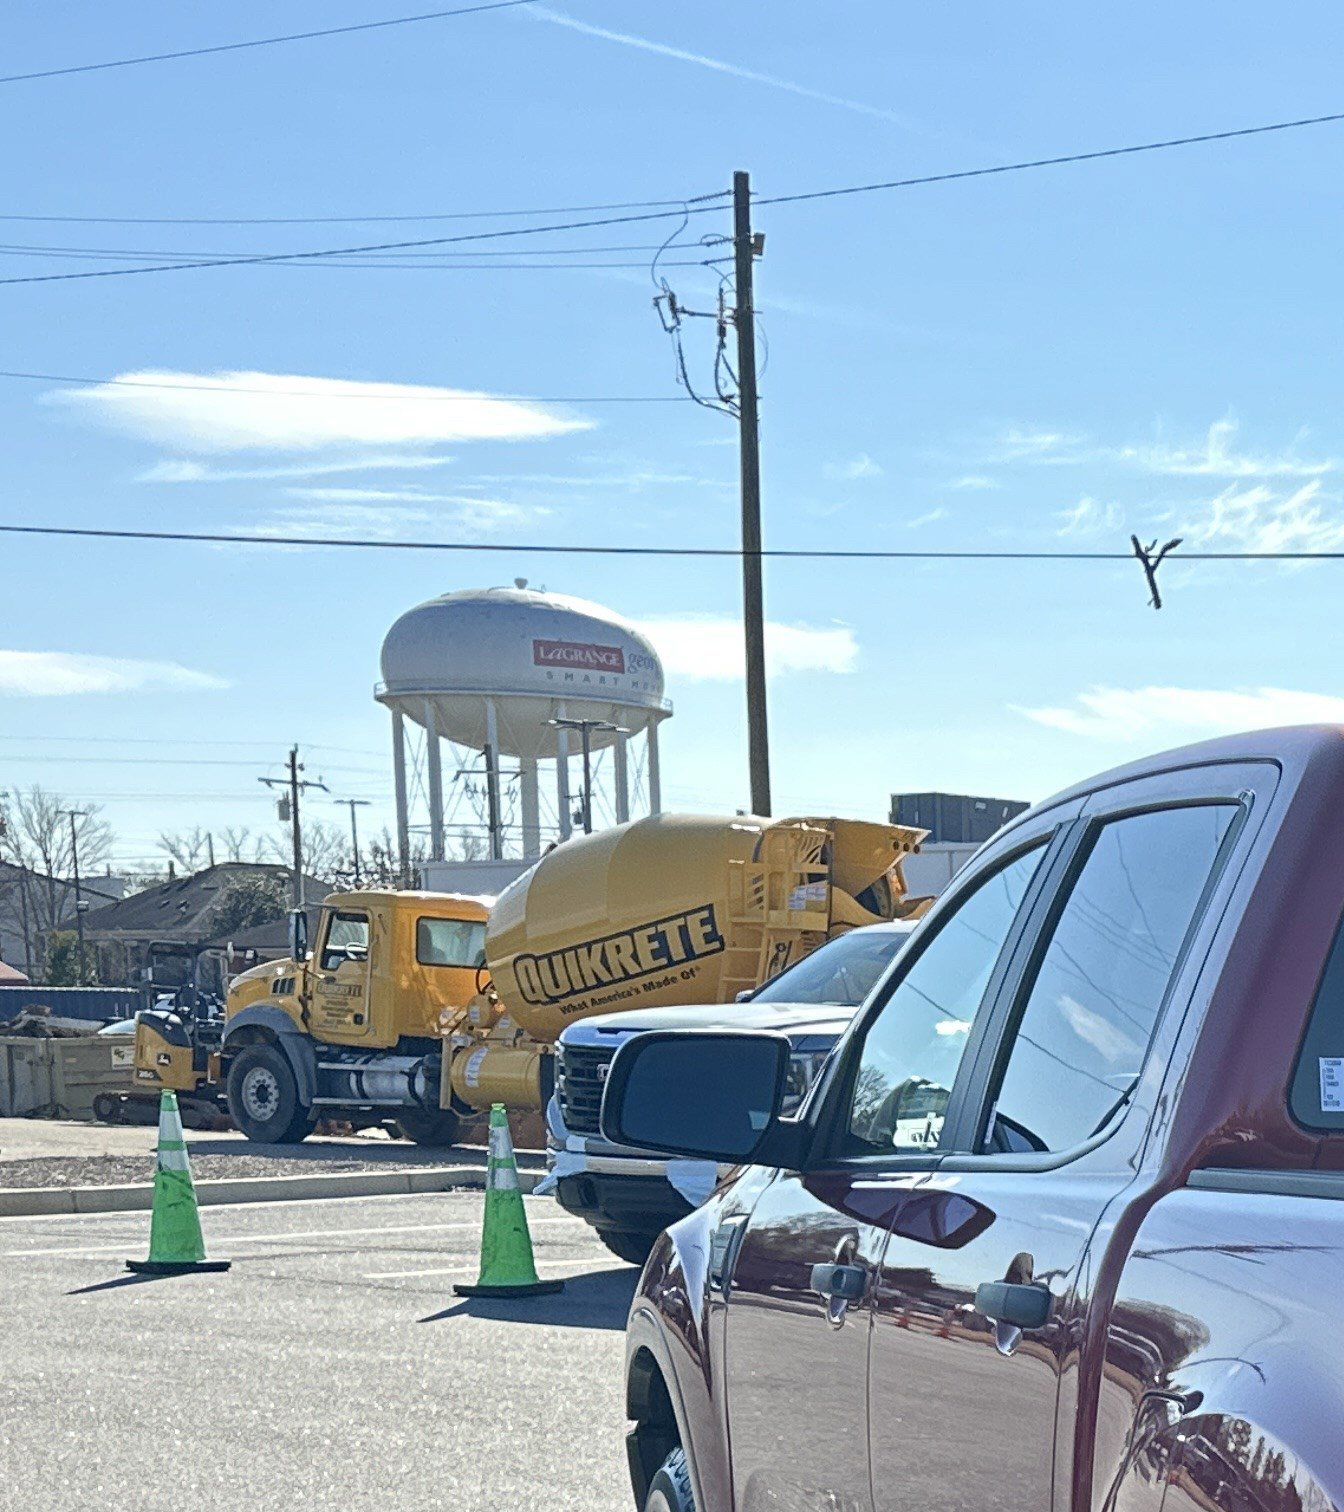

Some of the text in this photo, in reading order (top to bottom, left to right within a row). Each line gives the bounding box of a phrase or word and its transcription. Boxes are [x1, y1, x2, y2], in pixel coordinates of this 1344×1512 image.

[545, 670, 620, 685] SMART
[514, 908, 722, 1004] QUIKRETE
[560, 998, 588, 1015] What
[641, 975, 678, 993] Made
